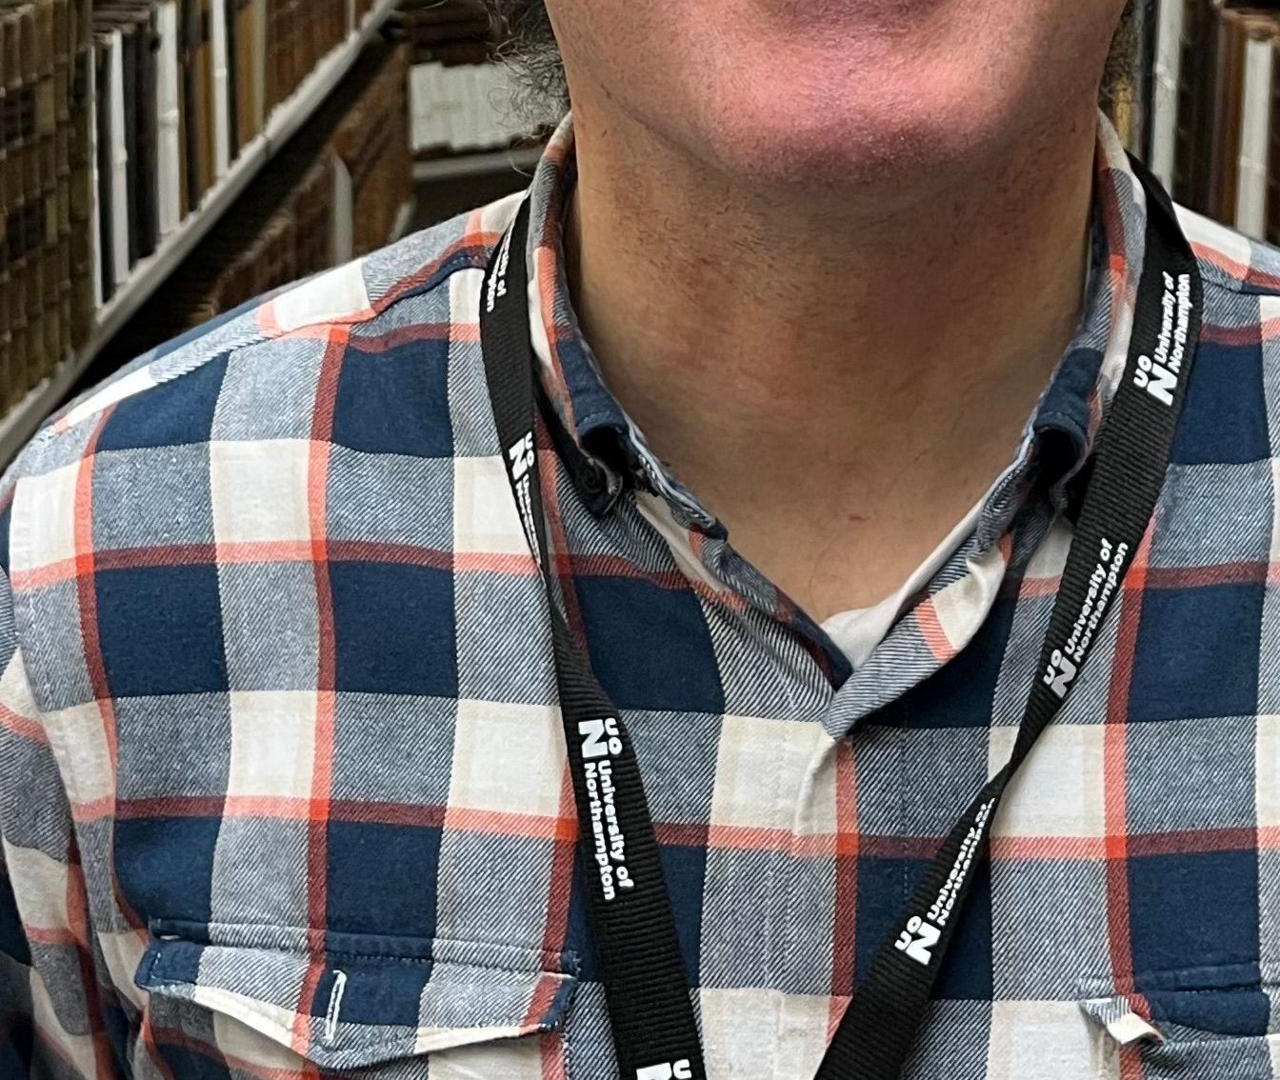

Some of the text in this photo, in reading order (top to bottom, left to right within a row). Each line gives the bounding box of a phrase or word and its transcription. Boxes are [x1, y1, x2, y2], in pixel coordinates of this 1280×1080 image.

[1153, 271, 1176, 364] University of
[1167, 274, 1193, 374] Northampton
[1064, 537, 1113, 655] University of
[1073, 542, 1129, 663] Northampton
[578, 719, 608, 758] N
[584, 762, 616, 901] Northampton
[598, 760, 634, 888] University of
[926, 827, 975, 921] University
